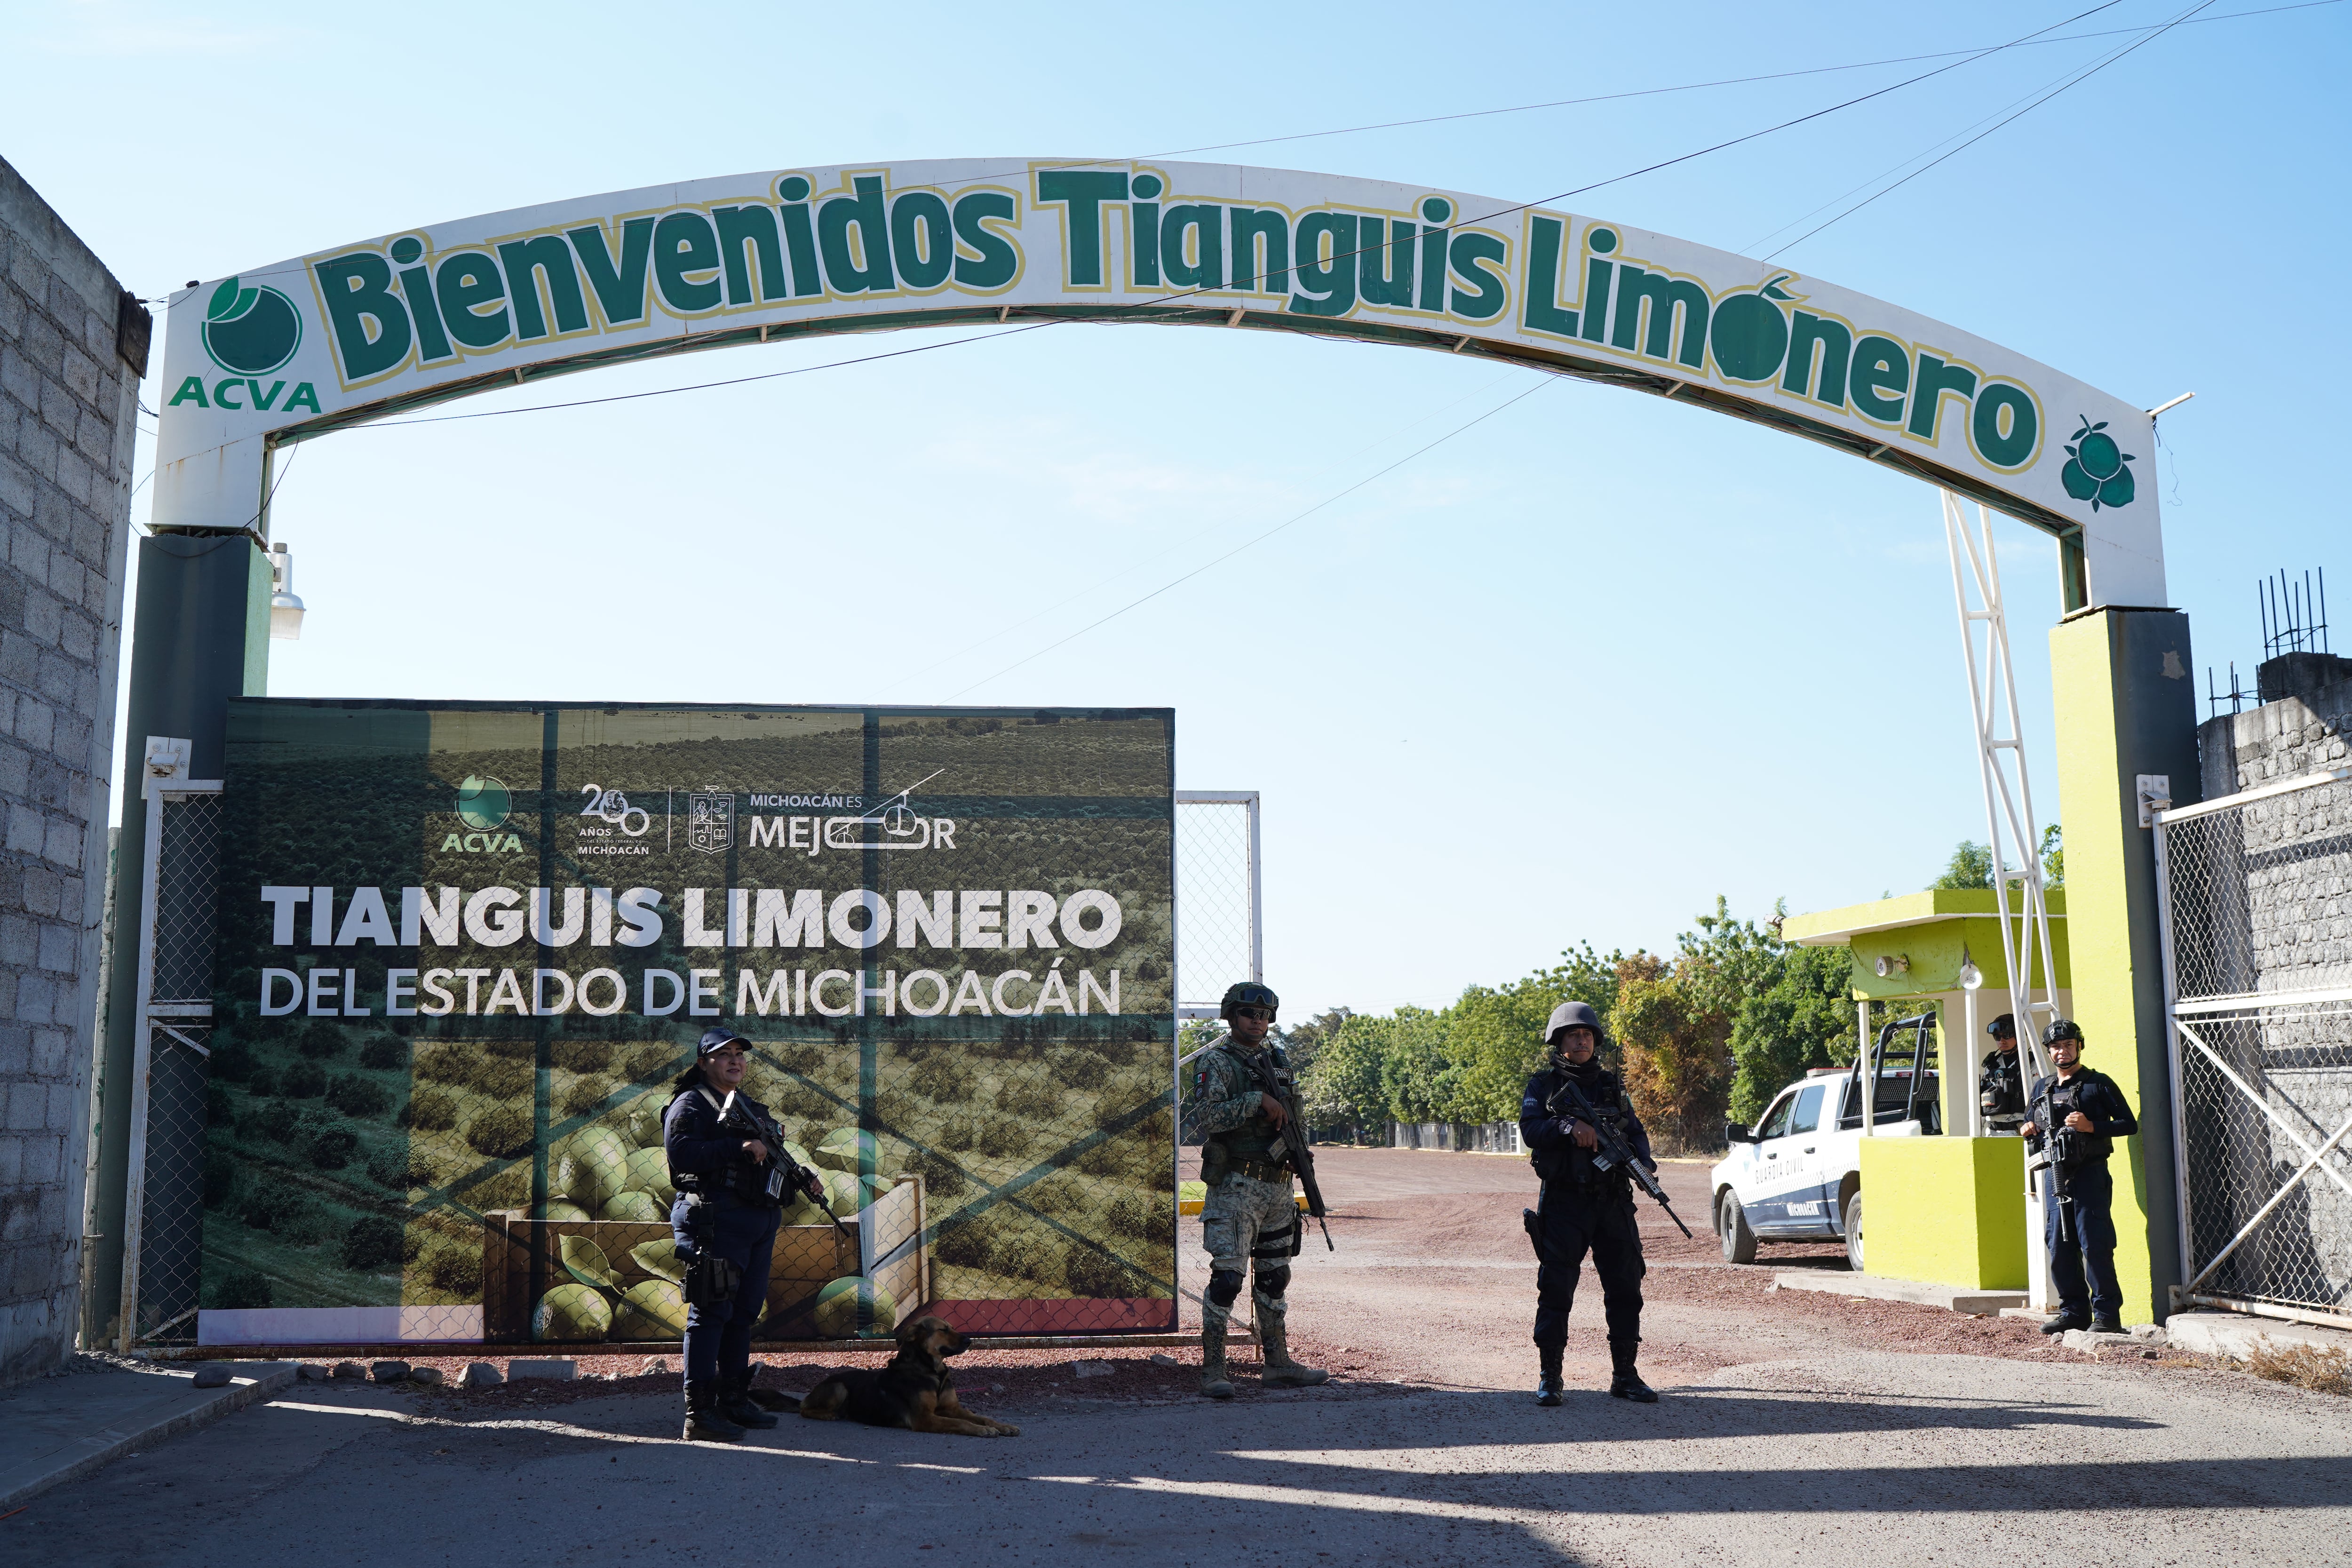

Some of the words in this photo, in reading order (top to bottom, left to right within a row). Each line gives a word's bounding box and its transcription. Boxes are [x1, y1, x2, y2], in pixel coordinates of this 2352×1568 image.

[315, 176, 1016, 379] Bienvenidos
[1039, 171, 1504, 317] Tianguis
[1525, 216, 2036, 466] Limonero
[167, 376, 321, 414] ACVA
[750, 794, 842, 808] MICHOACÁN
[847, 796, 862, 808] ES
[440, 833, 524, 852] ACVA
[579, 827, 611, 836] AÑOS
[579, 845, 649, 854] MICHOACÁN
[261, 885, 663, 947] TIANGUIS
[683, 888, 1122, 948] LIMONERO
[260, 968, 370, 1016] DEL
[387, 968, 627, 1017] ESTADO
[644, 968, 720, 1016] DE
[736, 957, 1120, 1017] MICHOACÁN
[1756, 1163, 1783, 1184] GUARDIA
[1786, 1156, 1803, 1176] CIVIL
